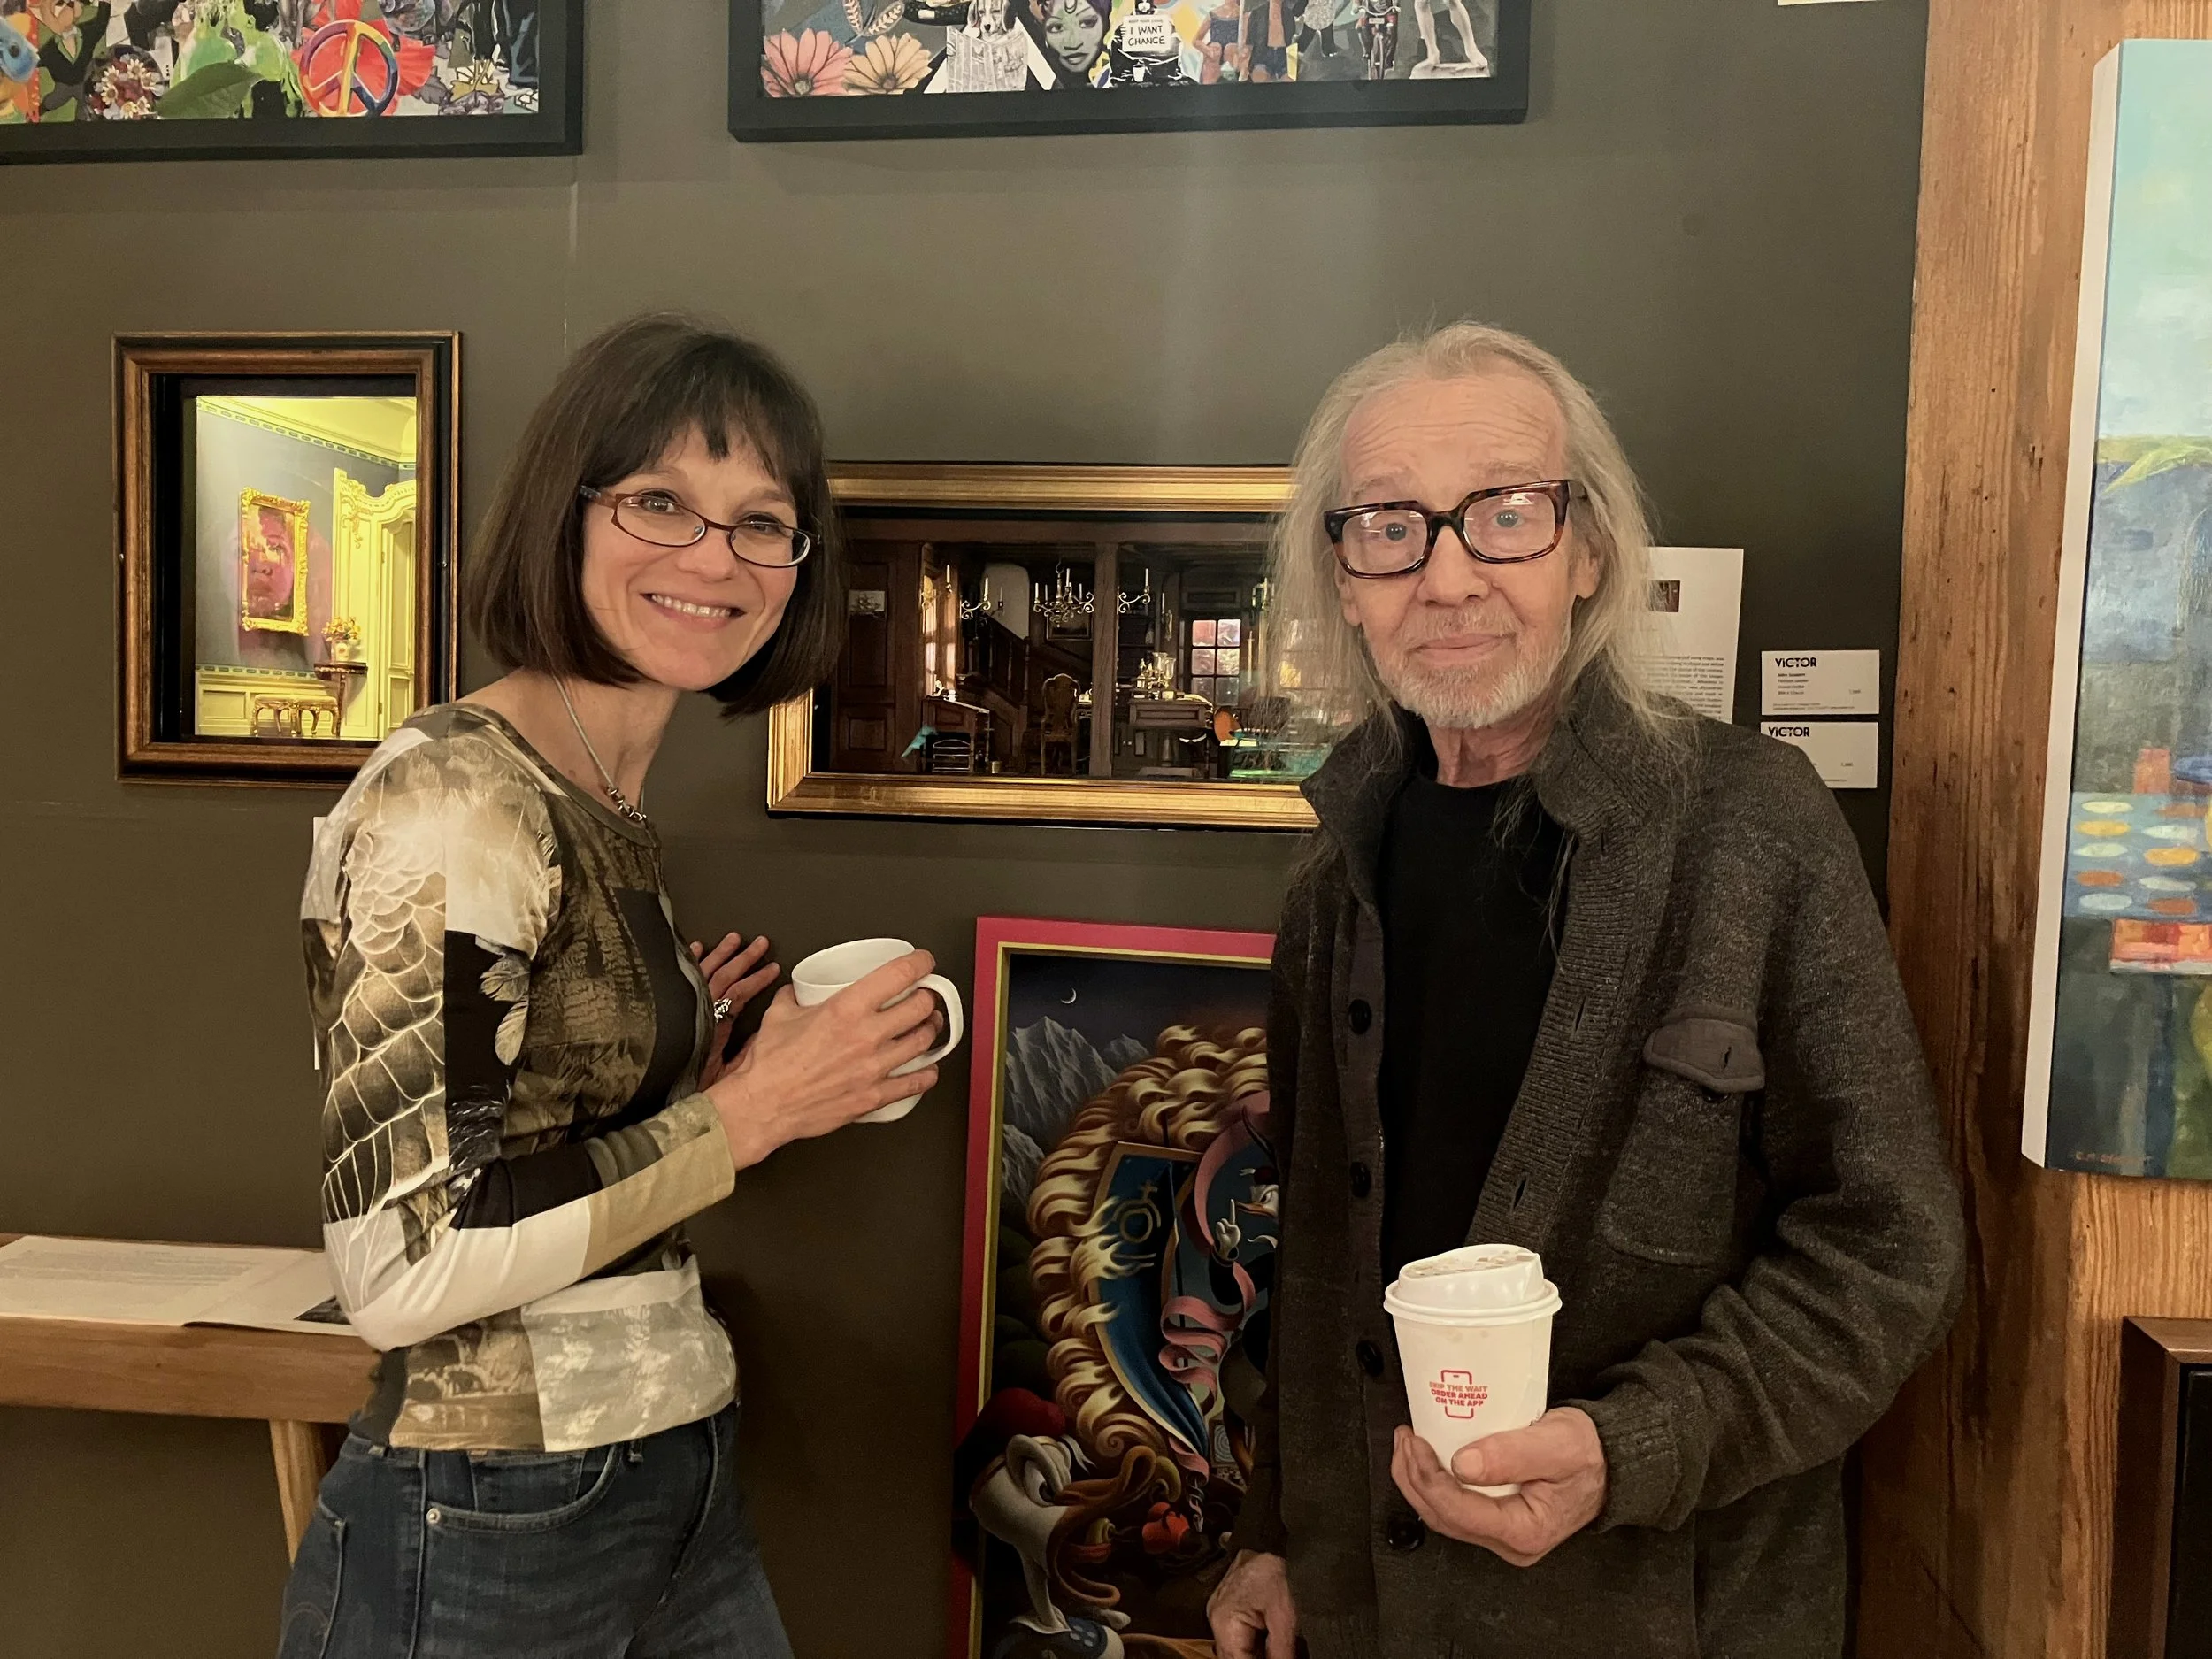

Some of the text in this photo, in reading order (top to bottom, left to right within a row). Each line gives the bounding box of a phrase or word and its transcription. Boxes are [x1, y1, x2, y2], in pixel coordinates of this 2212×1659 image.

[1138, 26, 1163, 35] WANT
[1128, 36, 1165, 46] CHANGE
[1775, 657, 1817, 668] VICTOR
[1768, 726, 1810, 737] VICTOR
[1432, 1389, 1456, 1398] ORDER
